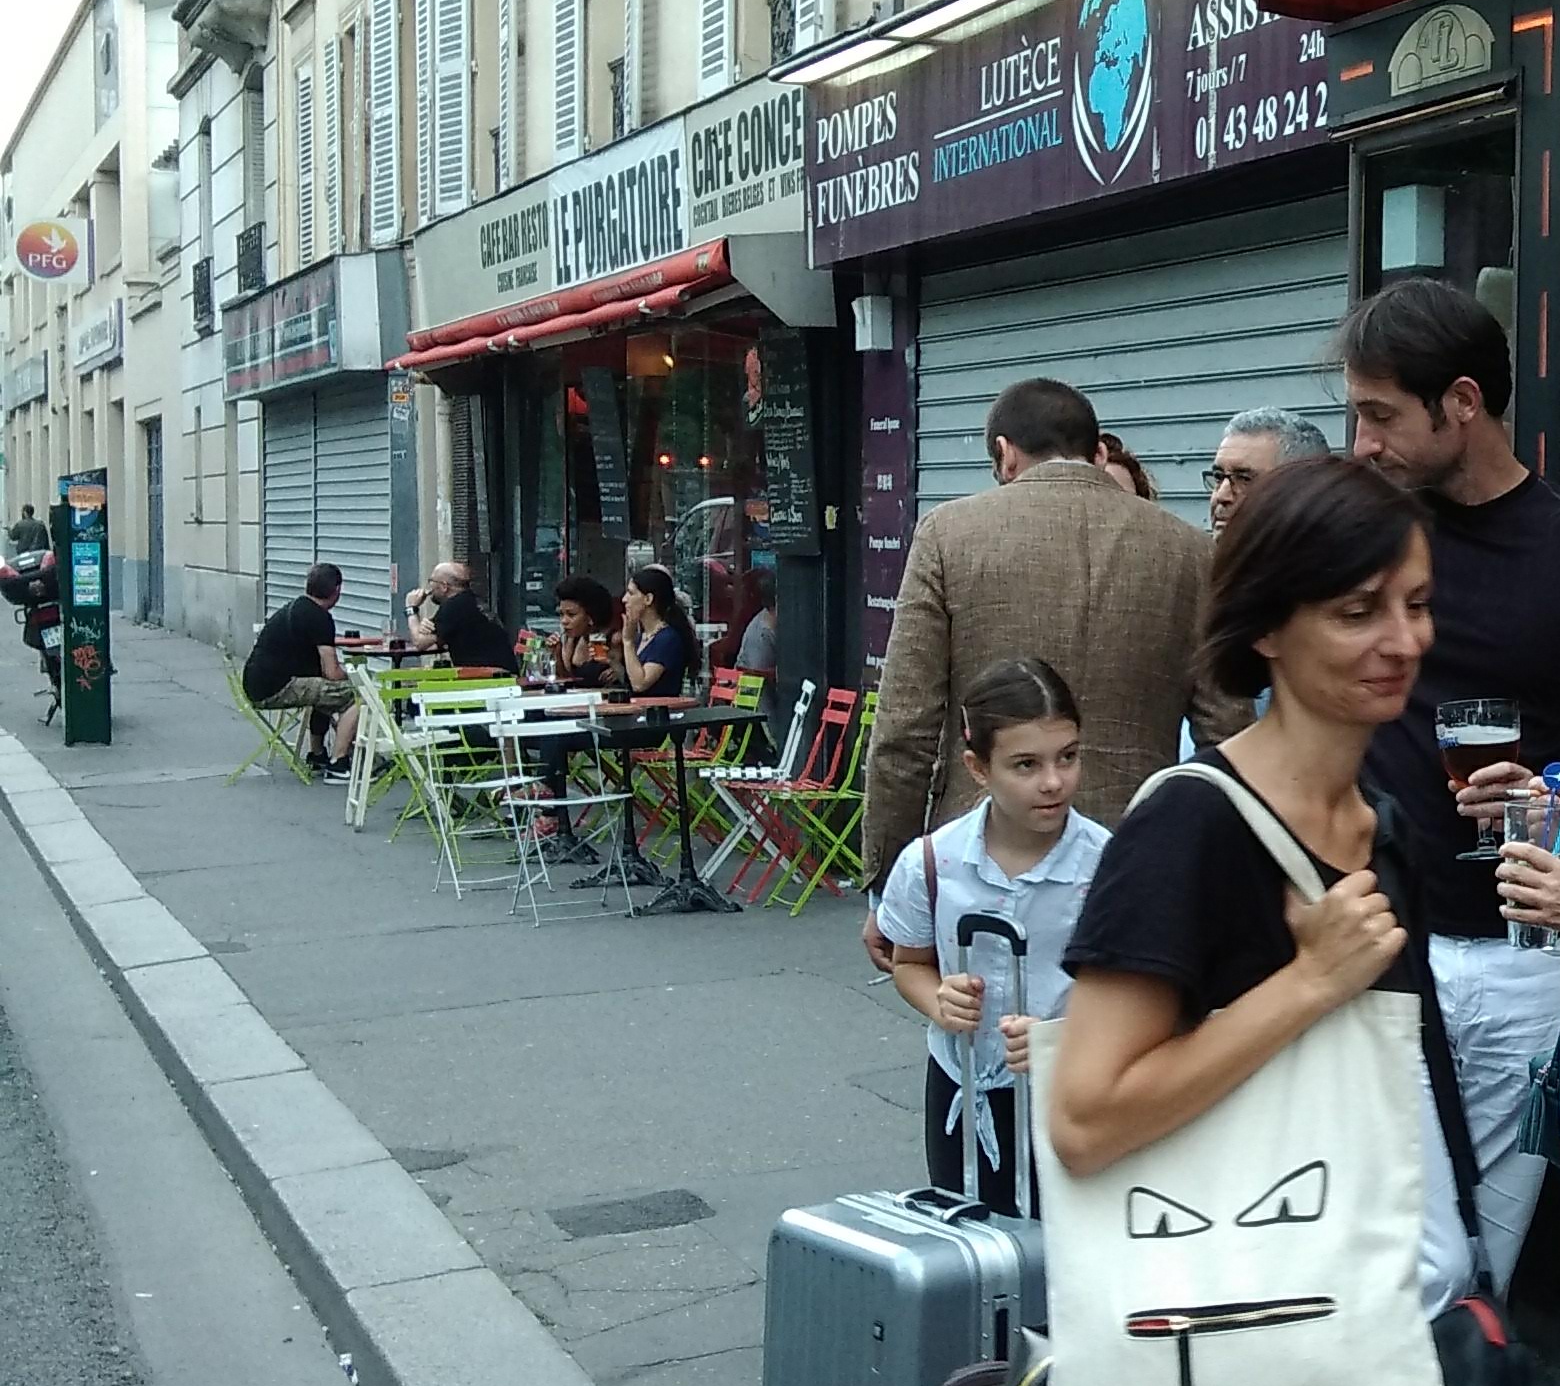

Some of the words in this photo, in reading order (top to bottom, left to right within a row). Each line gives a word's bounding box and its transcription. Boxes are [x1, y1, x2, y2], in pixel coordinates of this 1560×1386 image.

[979, 34, 1062, 113] LUTÈCE
[1194, 65, 1228, 104] jours
[1298, 28, 1326, 64] 24h
[815, 90, 898, 166] POMPES
[932, 107, 1064, 185] INTERNATIONAL
[1195, 115, 1217, 161] 01
[1223, 103, 1247, 152] 43
[1252, 94, 1279, 144] 48
[1282, 84, 1310, 137] 24
[552, 191, 572, 287] LE
[572, 147, 684, 281] PURGATOIRE
[815, 149, 921, 231] FUNÈBRES
[27, 251, 67, 270] PFG
[480, 221, 502, 269] CAFE
[502, 211, 520, 263] BAR
[520, 199, 550, 256] RESTO
